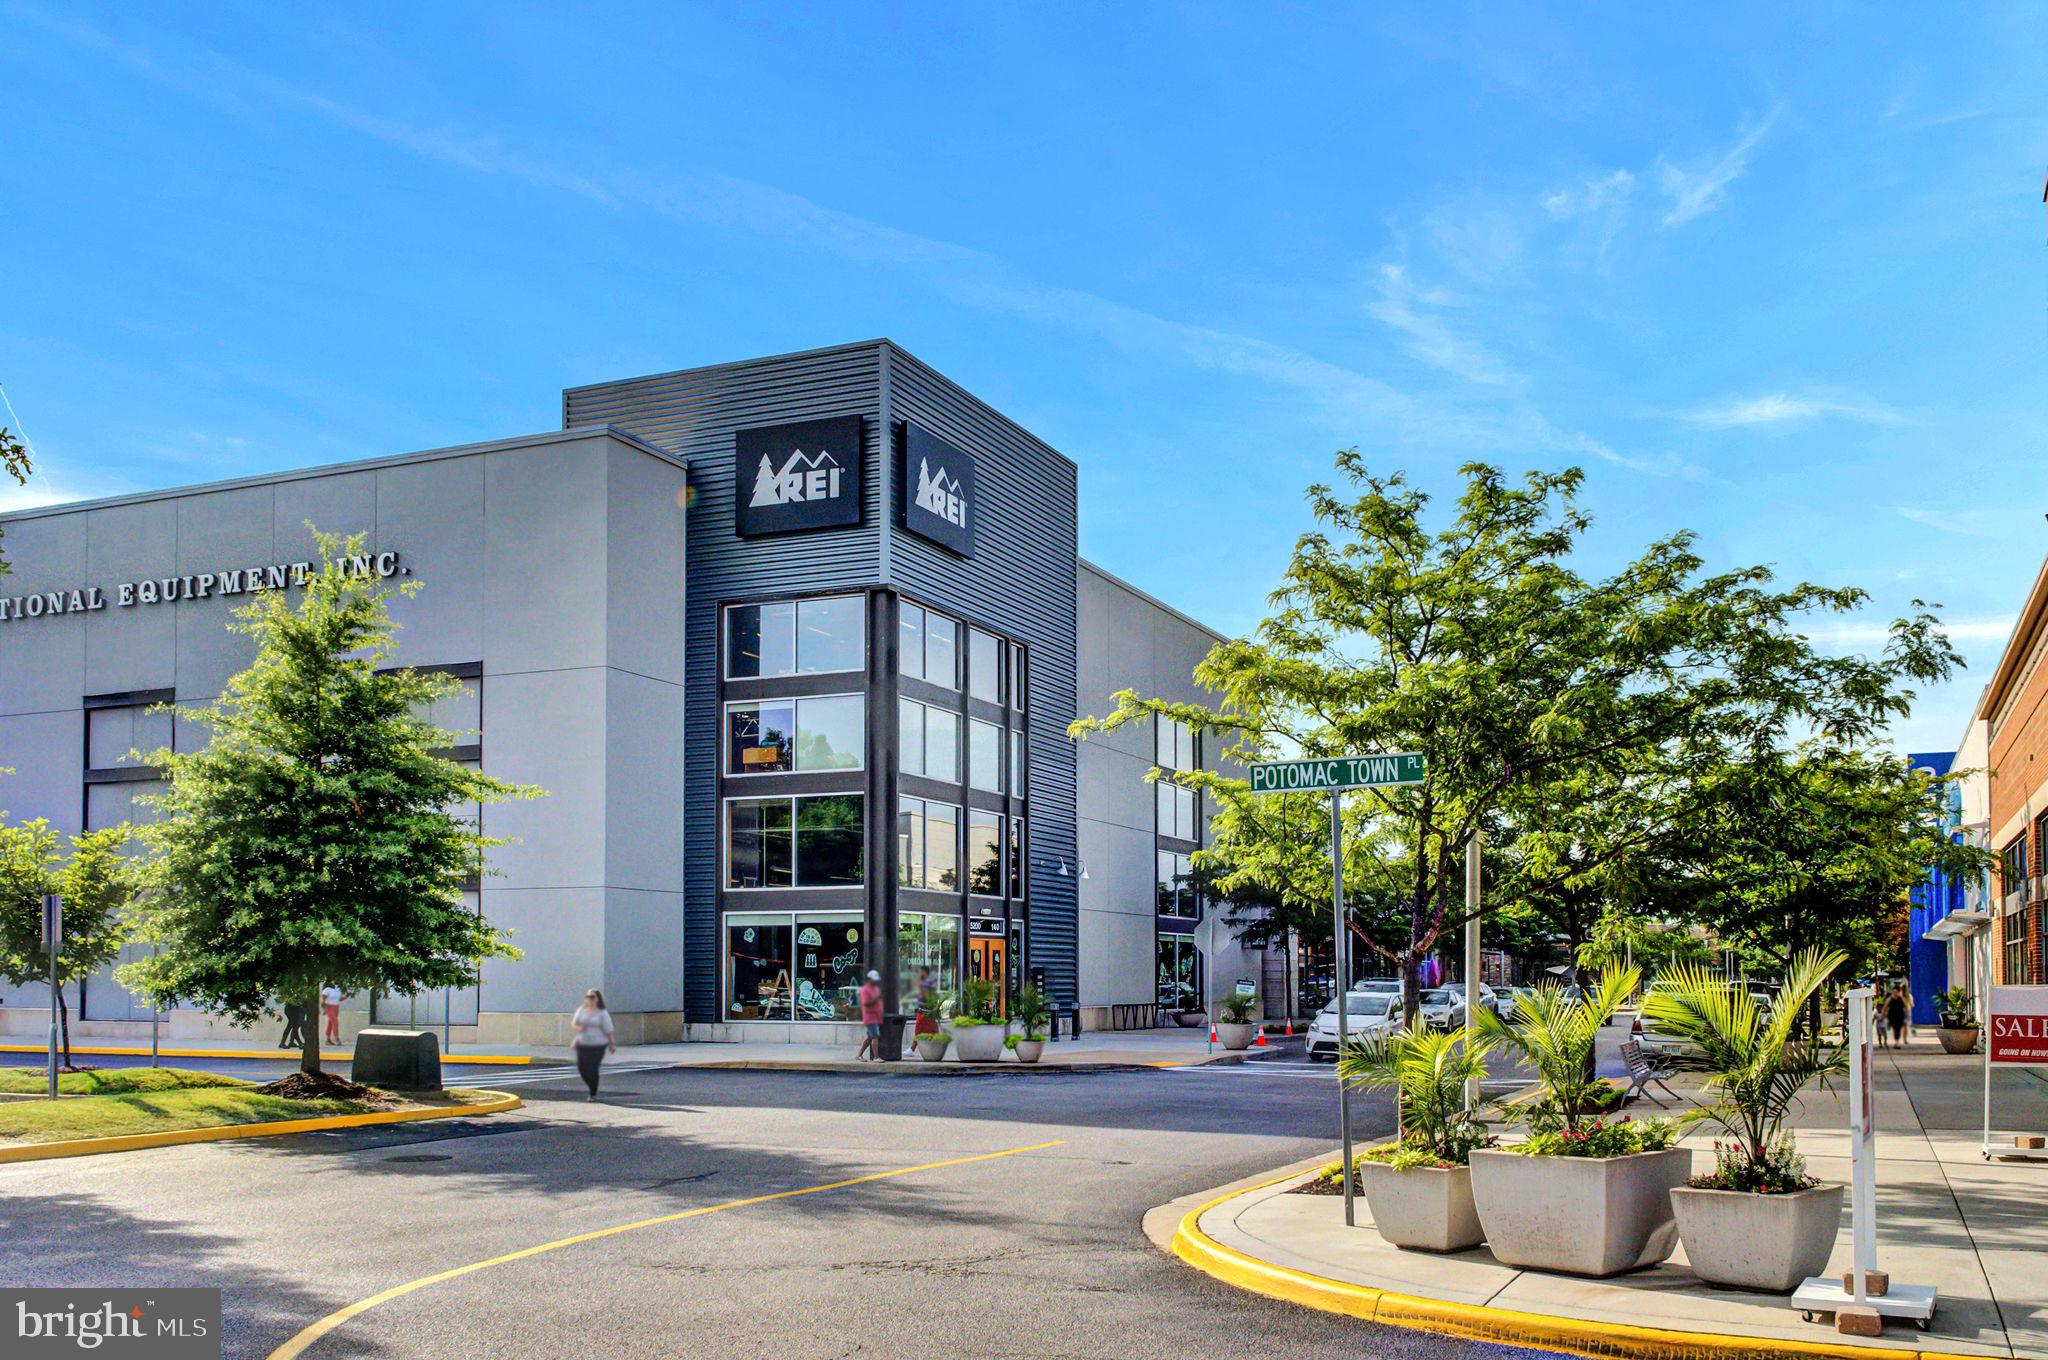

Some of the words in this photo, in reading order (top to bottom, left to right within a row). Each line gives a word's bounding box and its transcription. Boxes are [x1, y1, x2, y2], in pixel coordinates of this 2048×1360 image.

[0, 587, 103, 620] TIONAL
[336, 552, 408, 581] INC.
[1253, 762, 1339, 790] POTOMAC
[1347, 757, 1399, 784] TOWN
[1407, 756, 1420, 769] PL
[1999, 1048, 2019, 1056] GOING
